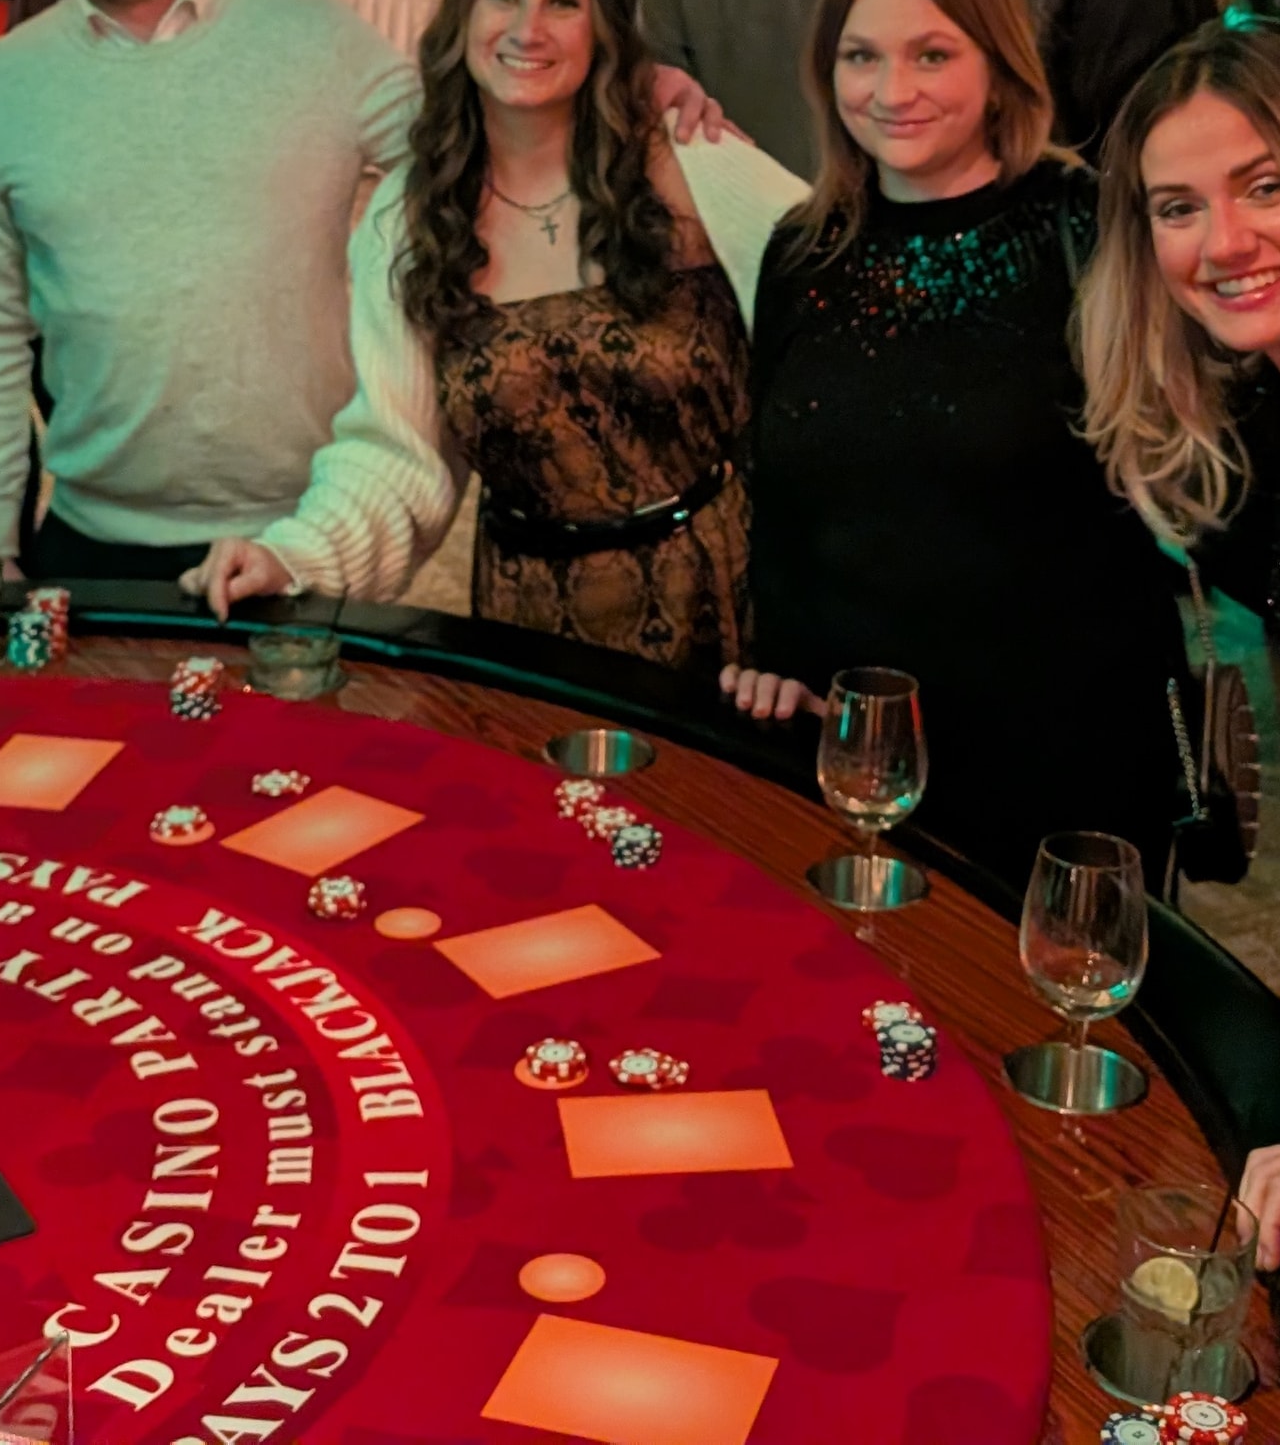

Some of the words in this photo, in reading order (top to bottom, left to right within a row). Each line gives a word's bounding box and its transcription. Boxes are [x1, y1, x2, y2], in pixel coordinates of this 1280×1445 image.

[50, 916, 134, 956] on
[127, 954, 279, 1057] stand
[176, 906, 425, 1123] BLACKJACK
[241, 1067, 315, 1186] must
[42, 1098, 220, 1349] CASINO
[85, 1203, 302, 1412] Dealer
[172, 1330, 350, 1445] AYS
